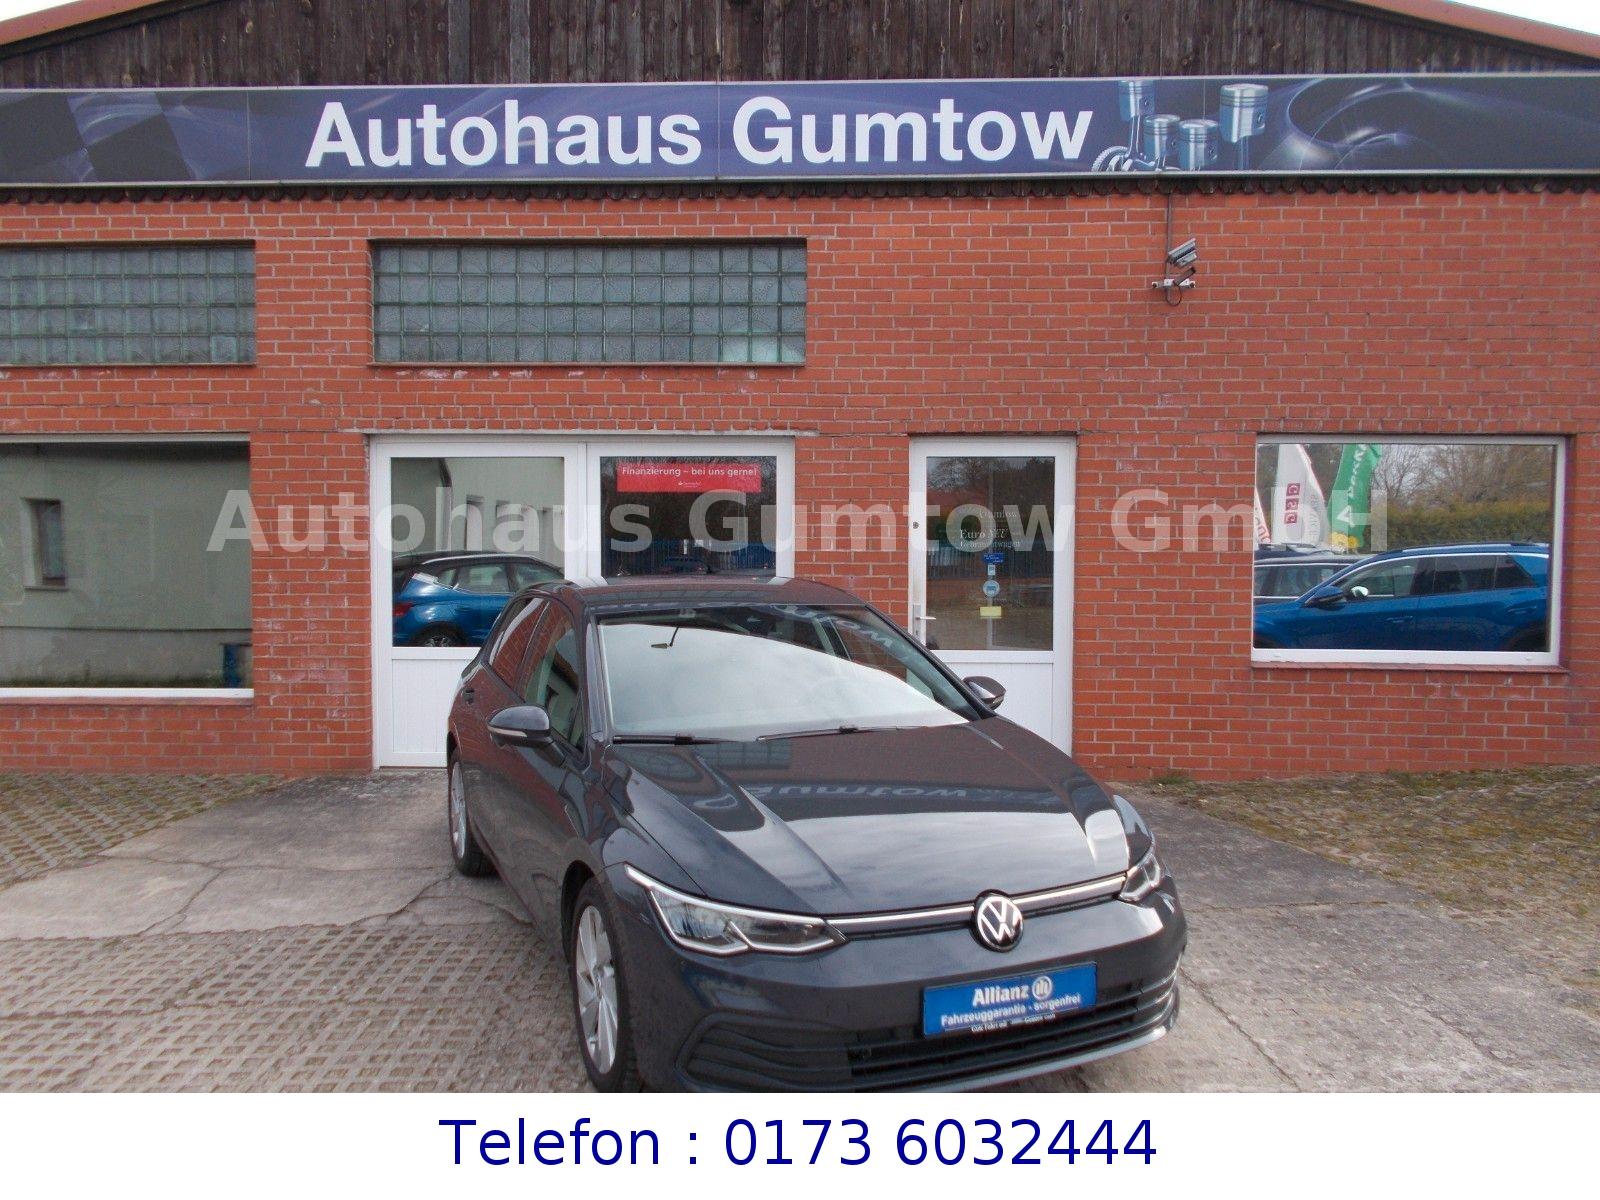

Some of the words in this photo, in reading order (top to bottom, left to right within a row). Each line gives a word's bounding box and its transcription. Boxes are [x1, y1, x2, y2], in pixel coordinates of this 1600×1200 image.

[305, 99, 702, 168] Autohaus
[733, 95, 1093, 165] Gumtow
[622, 466, 681, 478] Finanzierung
[691, 467, 706, 476] bei
[708, 468, 725, 476] uns
[727, 467, 757, 478] gerne!
[972, 984, 1029, 1007] Allianz
[941, 1004, 1026, 1026] Fahrzeuggarantie
